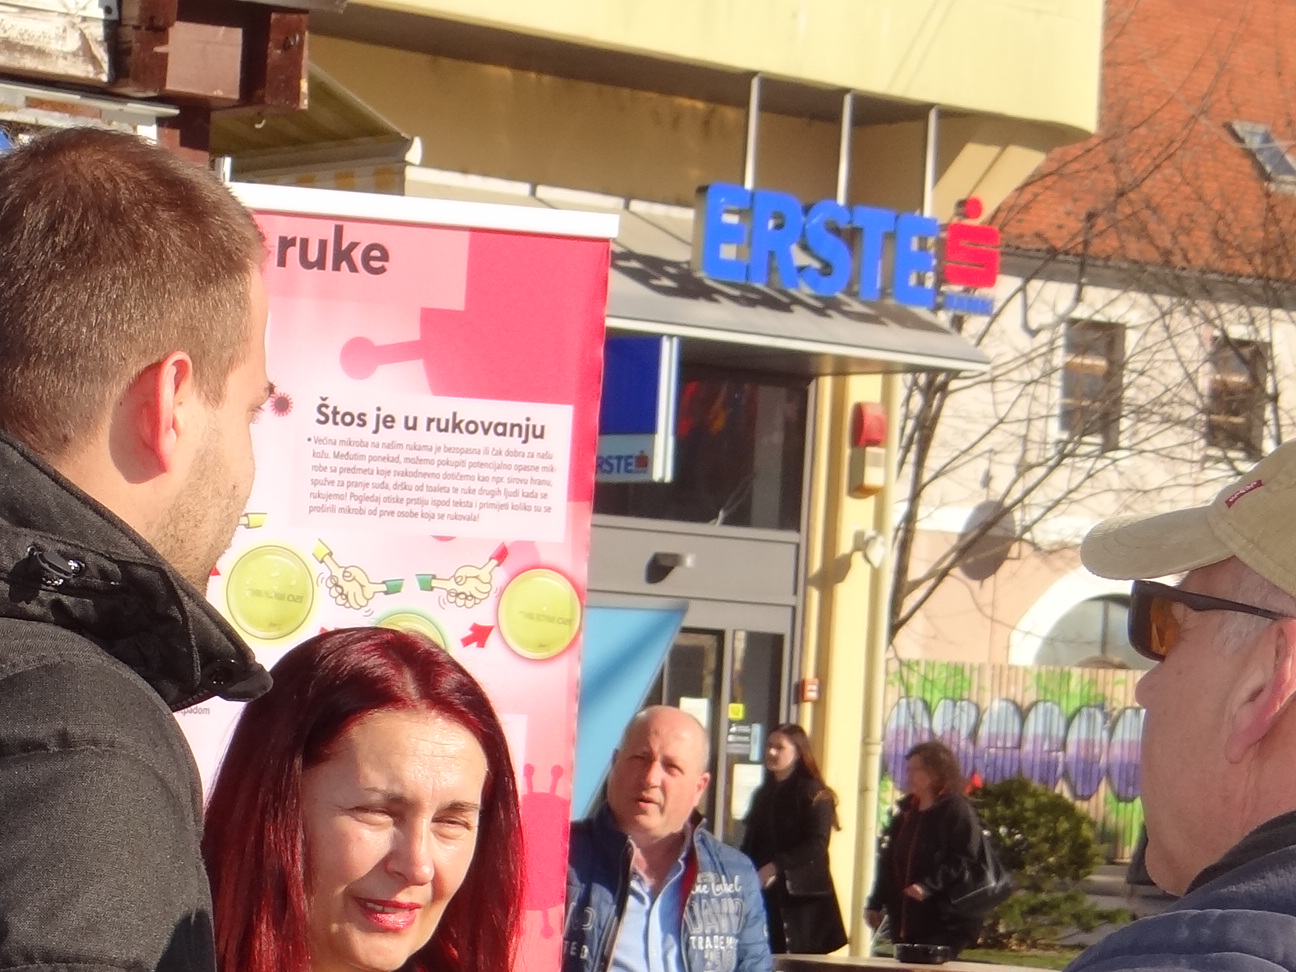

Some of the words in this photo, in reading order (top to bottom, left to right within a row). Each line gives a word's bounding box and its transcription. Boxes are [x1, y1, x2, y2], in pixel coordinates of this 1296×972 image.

[276, 224, 390, 275] ruke
[703, 182, 939, 310] ERSTE
[315, 396, 367, 427] Štos
[372, 406, 396, 434] je
[404, 415, 418, 431] u
[426, 411, 546, 444] rukovanju
[314, 436, 336, 445] Većina
[339, 438, 368, 448] mikroba
[382, 441, 403, 450] našim
[406, 442, 433, 451] rukama
[434, 445, 441, 454] je
[444, 444, 481, 455] bezopasna
[505, 448, 525, 458] dobra
[536, 451, 553, 459] našu
[312, 464, 327, 472] robe
[339, 466, 374, 475] predmeta
[376, 467, 391, 478] koje
[393, 469, 440, 479] svakodnevno
[442, 472, 475, 481] dotičemo
[477, 474, 489, 482] kao
[507, 476, 528, 484] sirovu
[404, 456, 434, 465] možemo
[437, 458, 466, 469] pokupiti
[468, 461, 512, 471] potencijalno
[514, 464, 539, 472] opasne
[596, 454, 634, 474] RSTE
[311, 478, 335, 487] spužve
[346, 480, 369, 490] pranje
[393, 482, 412, 491] dršku
[415, 483, 424, 492] od
[426, 484, 450, 493] toaleta
[461, 487, 476, 495] ruke
[478, 487, 501, 498] drugih
[504, 489, 519, 499] ljudi
[522, 490, 538, 499] kada
[350, 492, 381, 504] Pogledaj
[383, 495, 404, 504] otiske
[431, 498, 450, 508] ispod
[452, 499, 473, 507] teksta
[479, 501, 509, 512] primijeti
[511, 502, 532, 511] koliko
[338, 506, 366, 515] mikrobi
[368, 507, 377, 516] od
[379, 509, 395, 518] prve
[397, 509, 418, 518] osobe
[421, 510, 435, 521] koja
[437, 512, 445, 520] se
